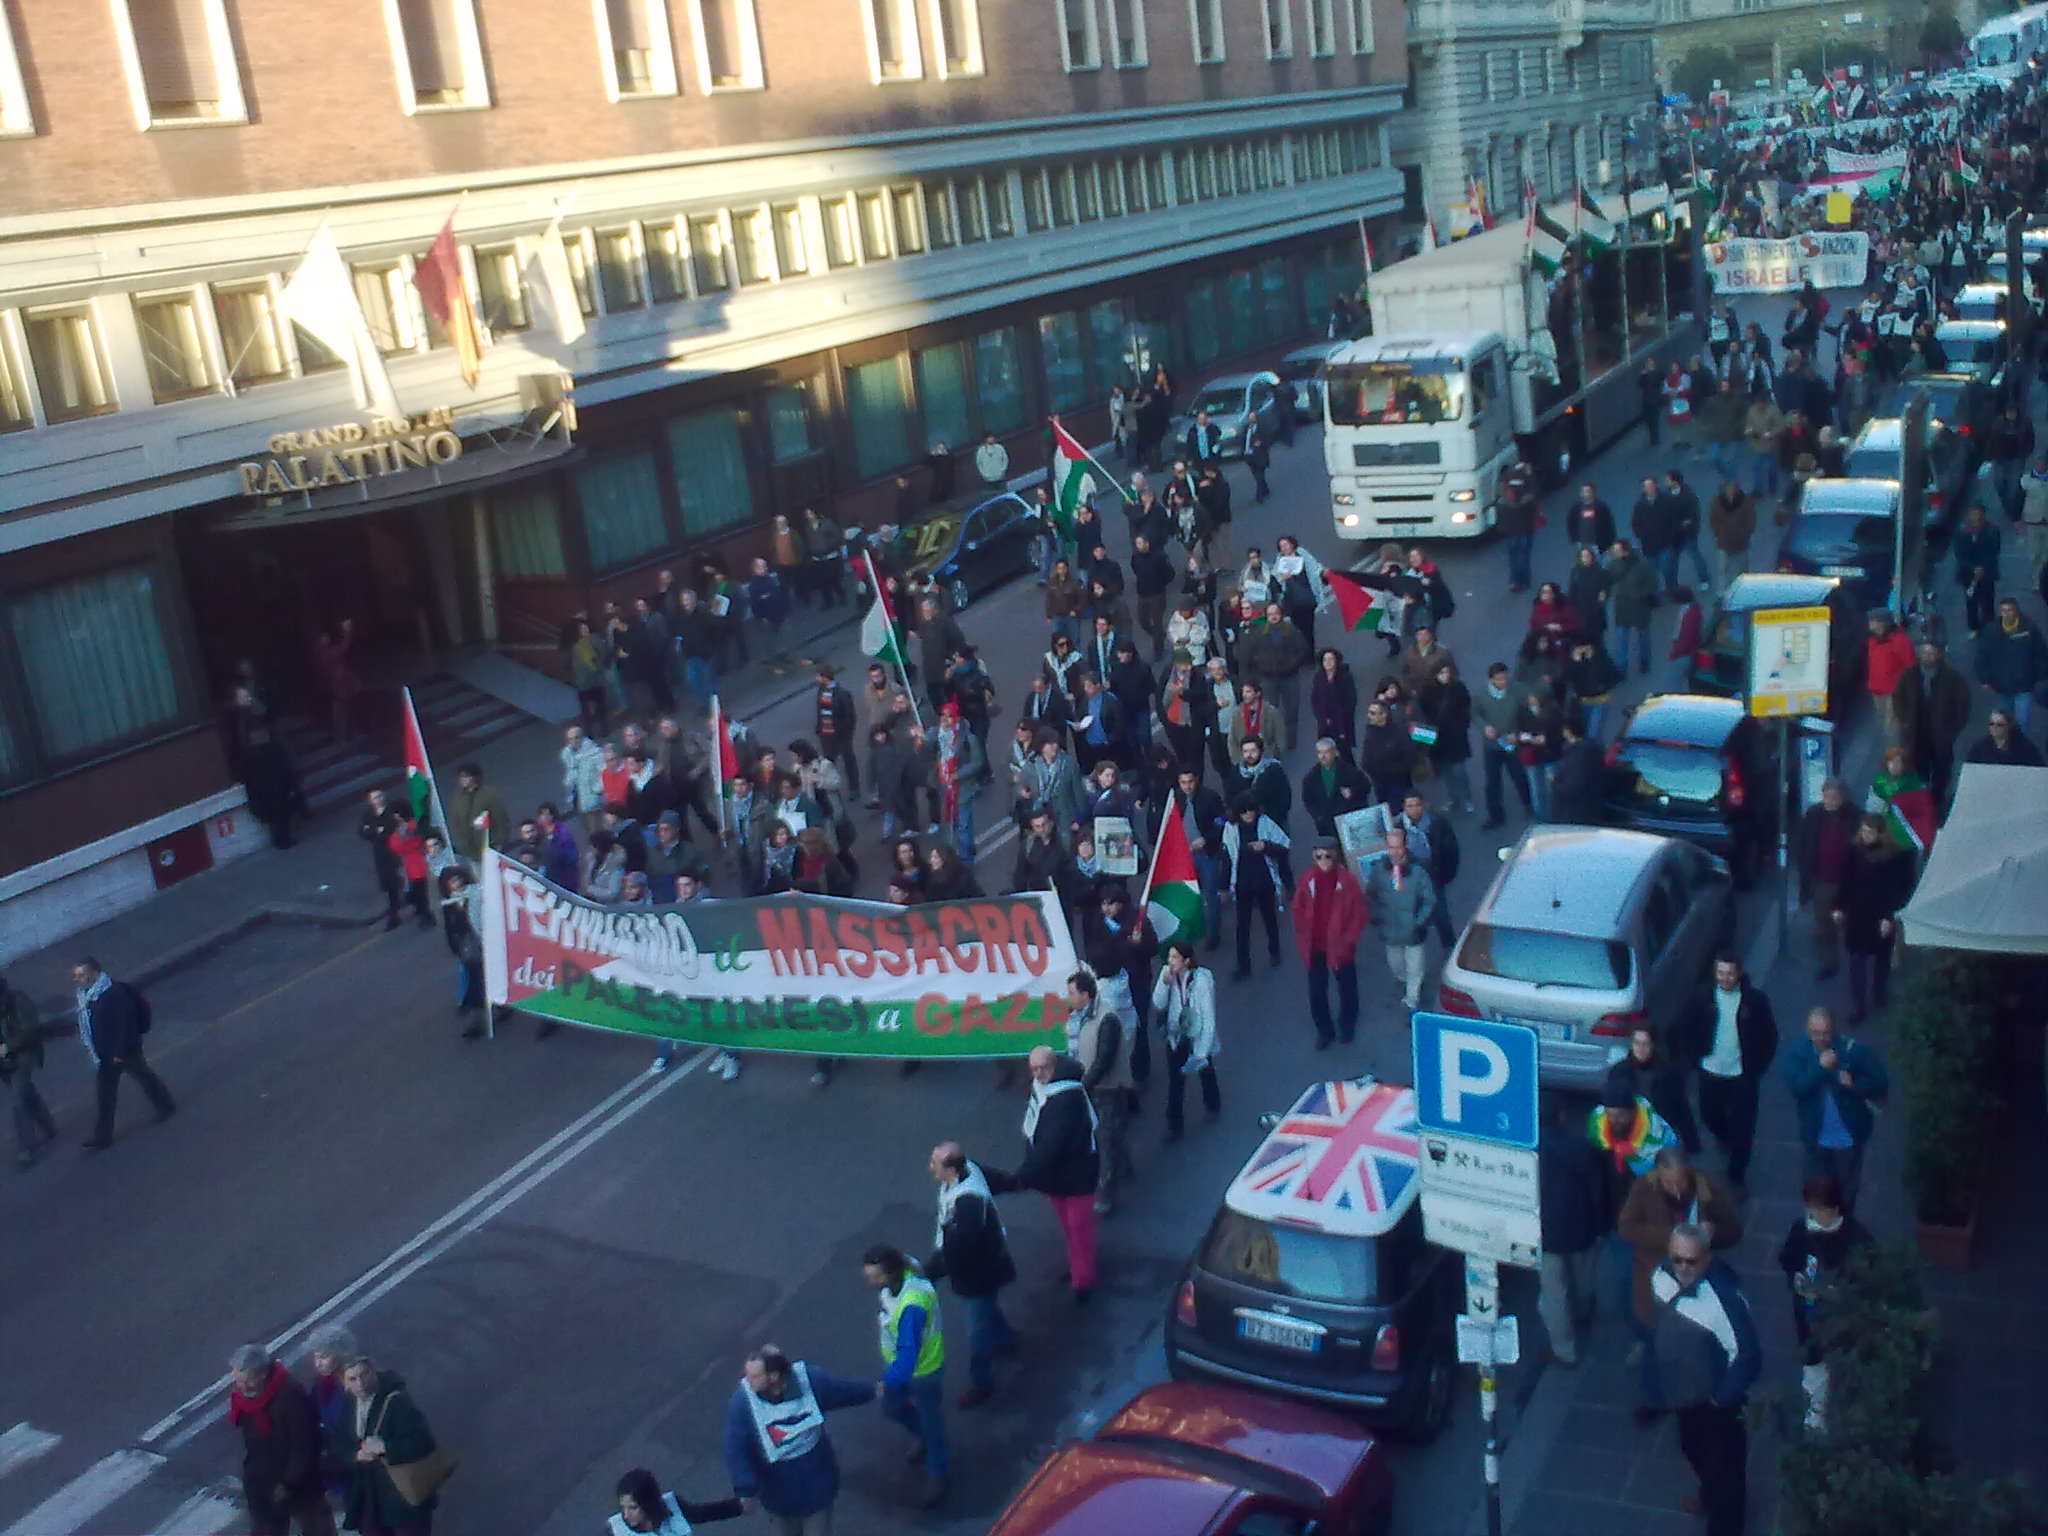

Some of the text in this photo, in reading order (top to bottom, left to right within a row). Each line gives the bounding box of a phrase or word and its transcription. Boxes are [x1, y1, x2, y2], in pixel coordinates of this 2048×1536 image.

[1726, 264, 1810, 286] ISRAELE
[239, 430, 463, 496] PALATINO
[269, 422, 364, 453] GRAND
[714, 932, 752, 972] il
[757, 902, 1048, 978] MASSACRO
[513, 956, 1070, 1034] dei PALESTINESI a GAZA
[1440, 1028, 1511, 1123] P
